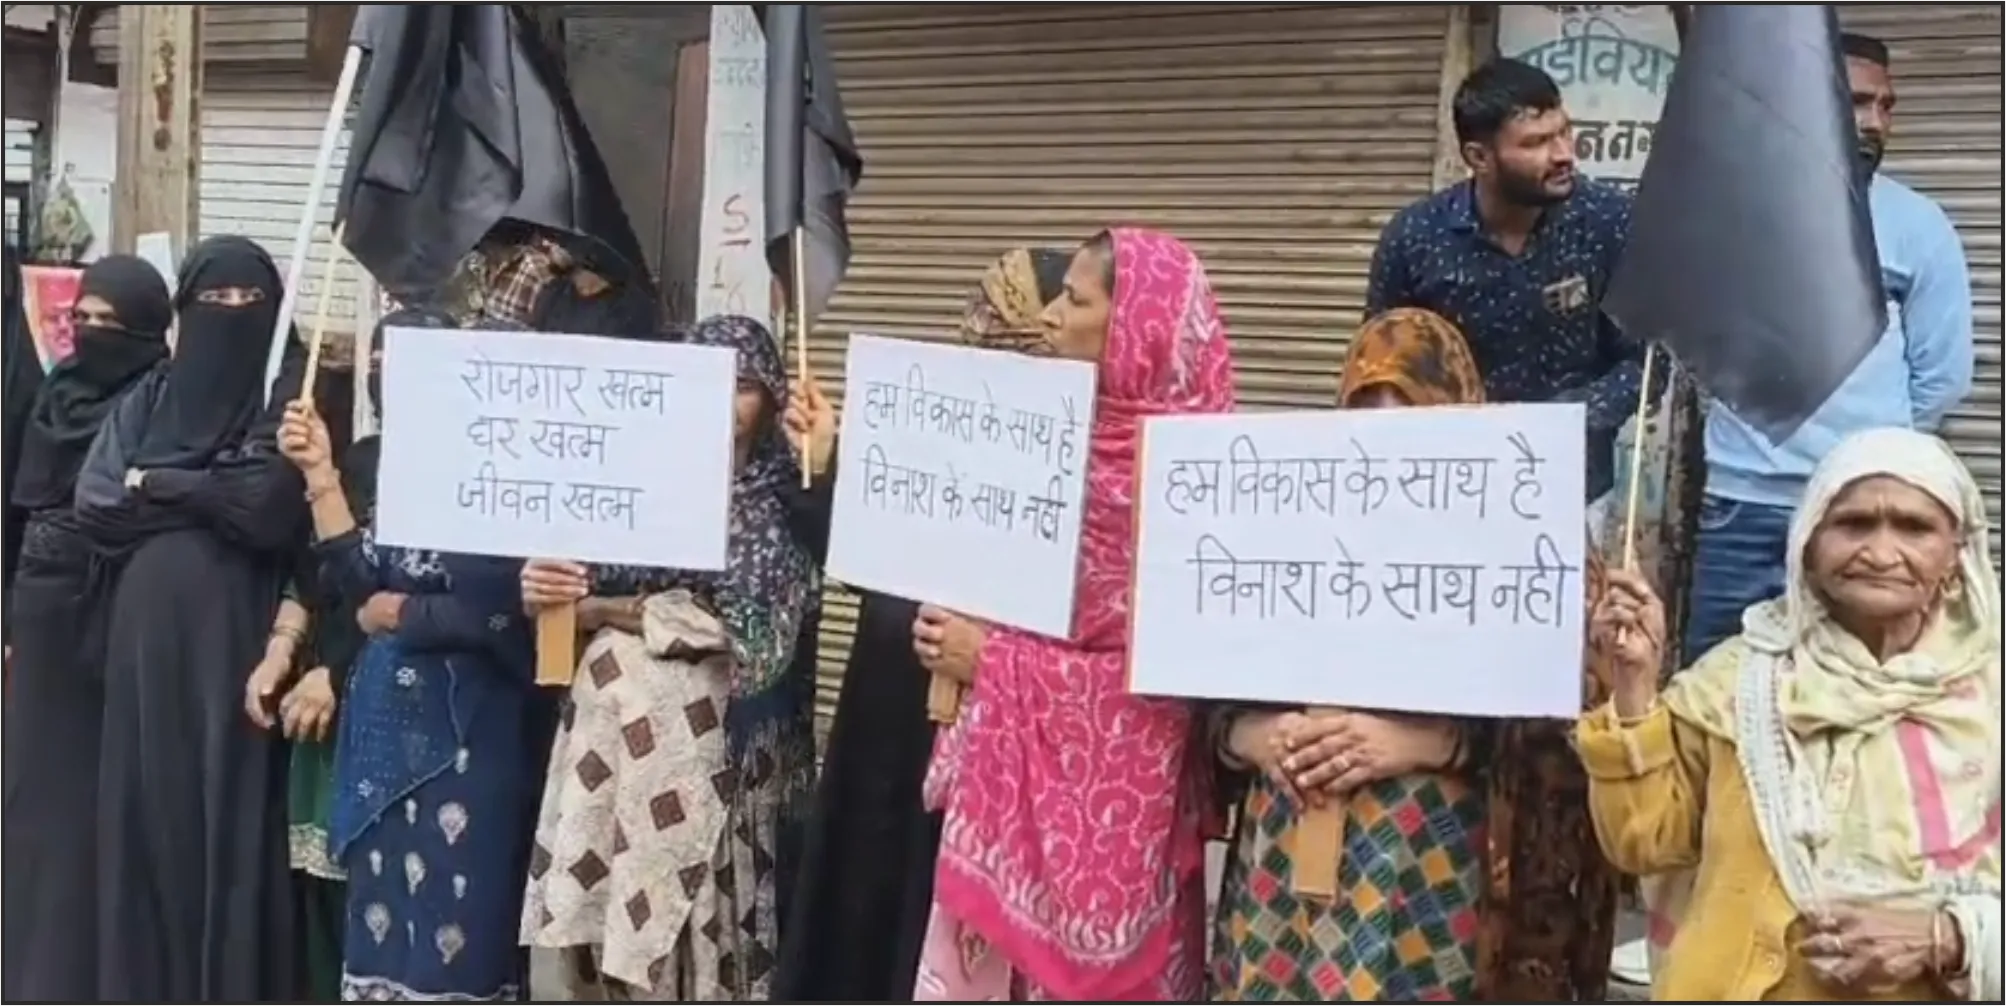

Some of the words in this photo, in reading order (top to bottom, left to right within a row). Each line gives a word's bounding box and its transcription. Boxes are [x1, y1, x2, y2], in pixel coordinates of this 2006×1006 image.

[460, 345, 588, 417] रोजगार
[598, 368, 675, 415] खत्म
[863, 381, 900, 429] हम
[903, 361, 977, 444] विकास
[979, 378, 1001, 444] के
[1005, 407, 1056, 465] साथ
[1057, 394, 1084, 476] है
[466, 415, 523, 459] घर
[529, 420, 621, 464] खत्म
[1165, 459, 1221, 515] हम
[1227, 433, 1345, 517] विकास
[1344, 438, 1390, 516] के
[1397, 458, 1498, 518] साथ
[1507, 431, 1547, 520] है
[456, 460, 553, 523] जीवन
[561, 482, 645, 530] खत्म
[859, 442, 938, 520] विनाश
[971, 482, 1017, 531] साथ
[1021, 474, 1069, 544] नही
[1186, 533, 1327, 620] विनाश
[1328, 535, 1373, 620] के
[1381, 562, 1486, 627] साथ
[1491, 532, 1580, 629] नही
